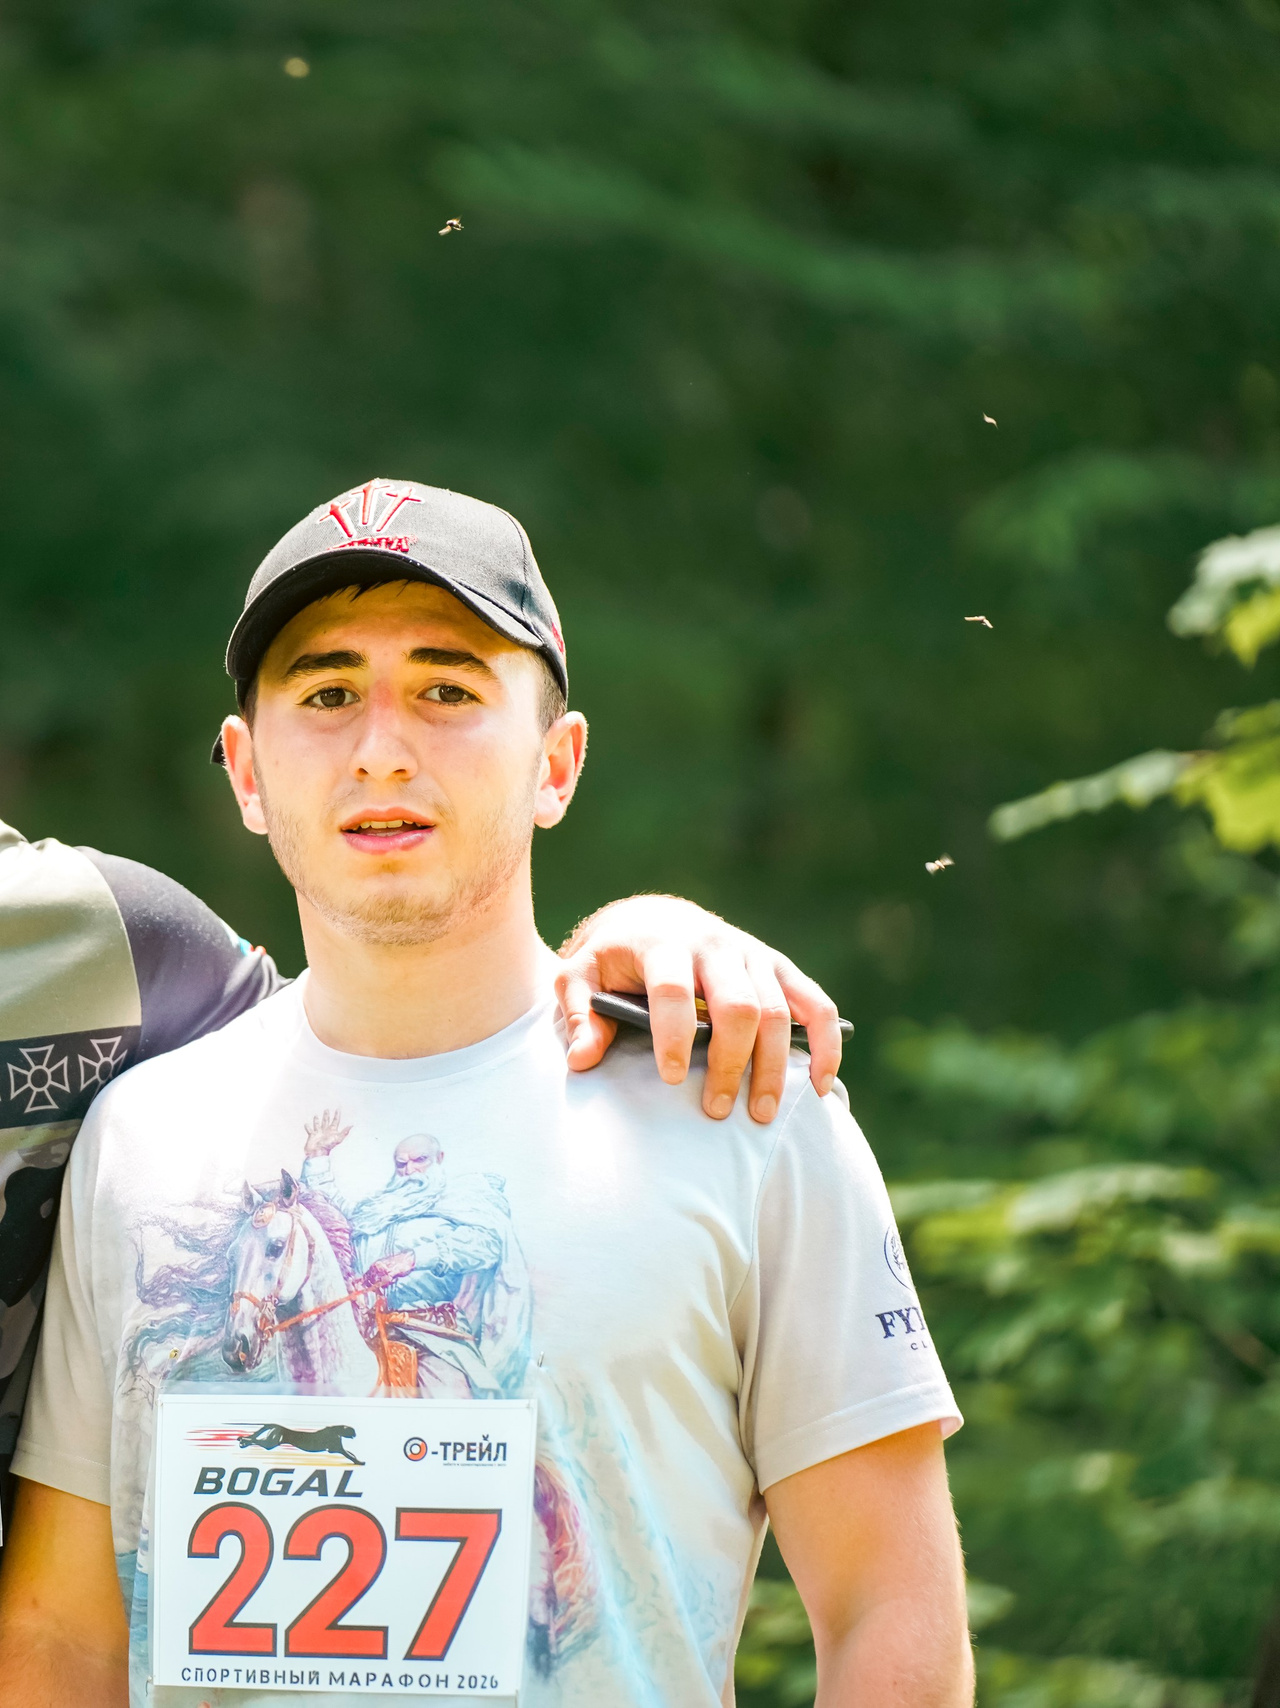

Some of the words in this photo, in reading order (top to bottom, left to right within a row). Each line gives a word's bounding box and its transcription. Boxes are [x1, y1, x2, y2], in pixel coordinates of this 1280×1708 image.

[193, 1466, 363, 1498] BOGAL
[187, 1501, 502, 1661] 227
[181, 1666, 320, 1685] СПОРТИВНЫЙ
[328, 1671, 449, 1689] МАРАФОН
[457, 1675, 499, 1689] 2026
